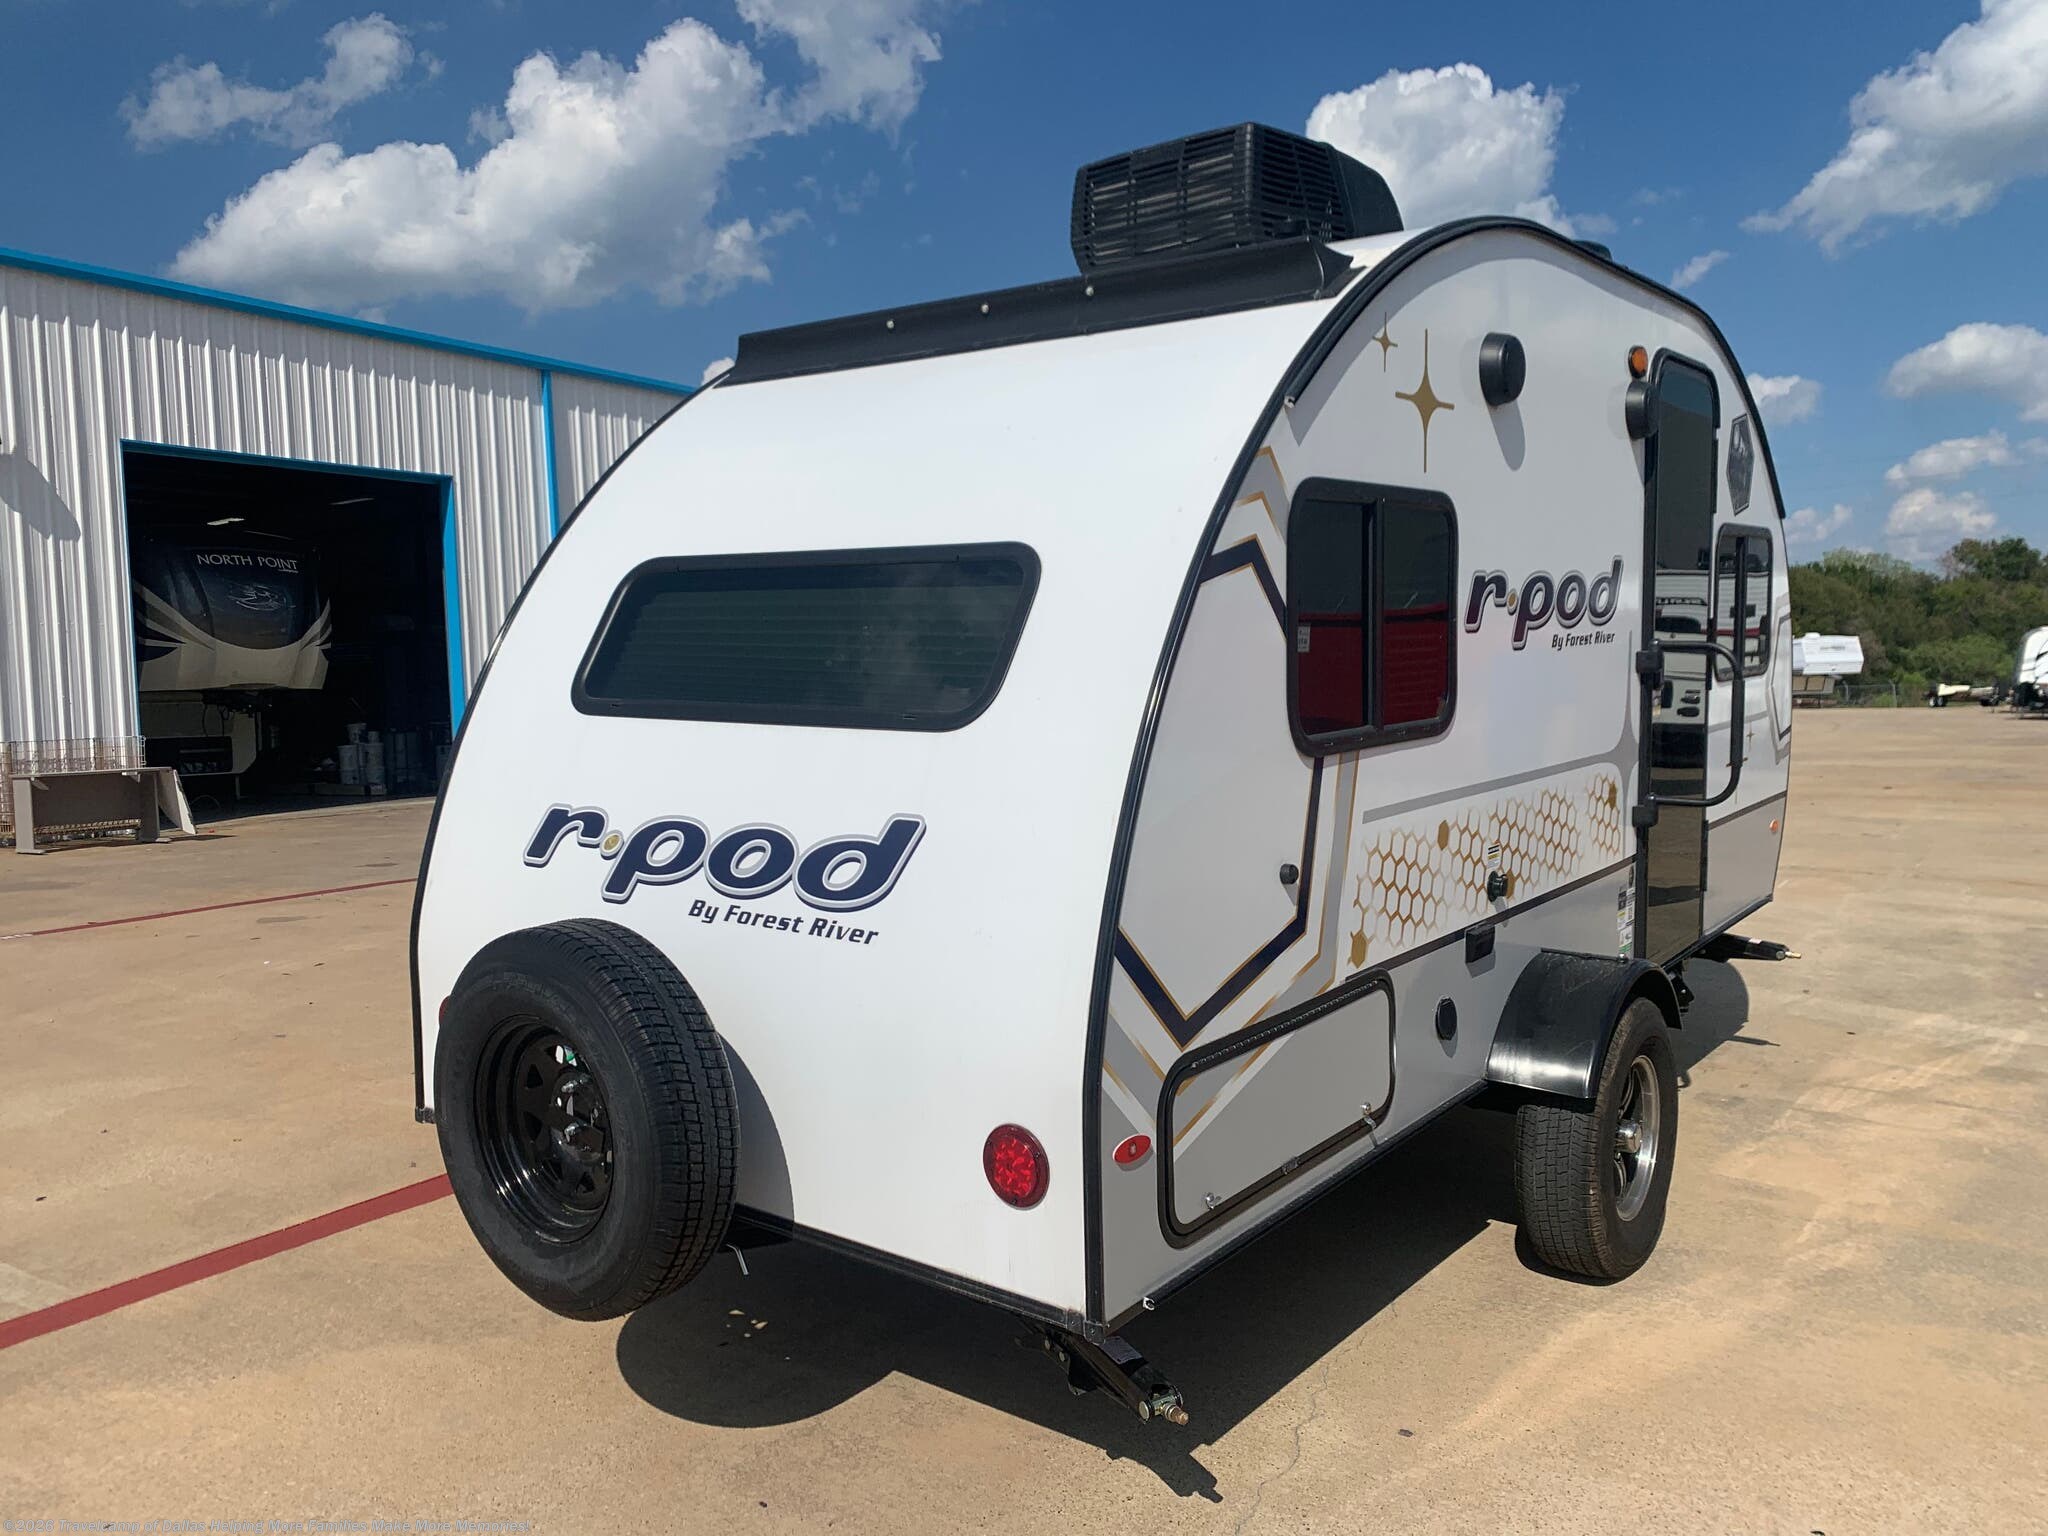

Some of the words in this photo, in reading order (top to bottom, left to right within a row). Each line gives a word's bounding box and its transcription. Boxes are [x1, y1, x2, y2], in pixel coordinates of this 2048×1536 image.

[196, 554, 252, 566] NORTH
[257, 556, 297, 570] POINT
[1551, 634, 1563, 651] By
[1565, 633, 1593, 647] Forest
[1595, 631, 1615, 645] River
[688, 899, 720, 924] By
[723, 904, 804, 934] Forest
[808, 917, 880, 945] River
